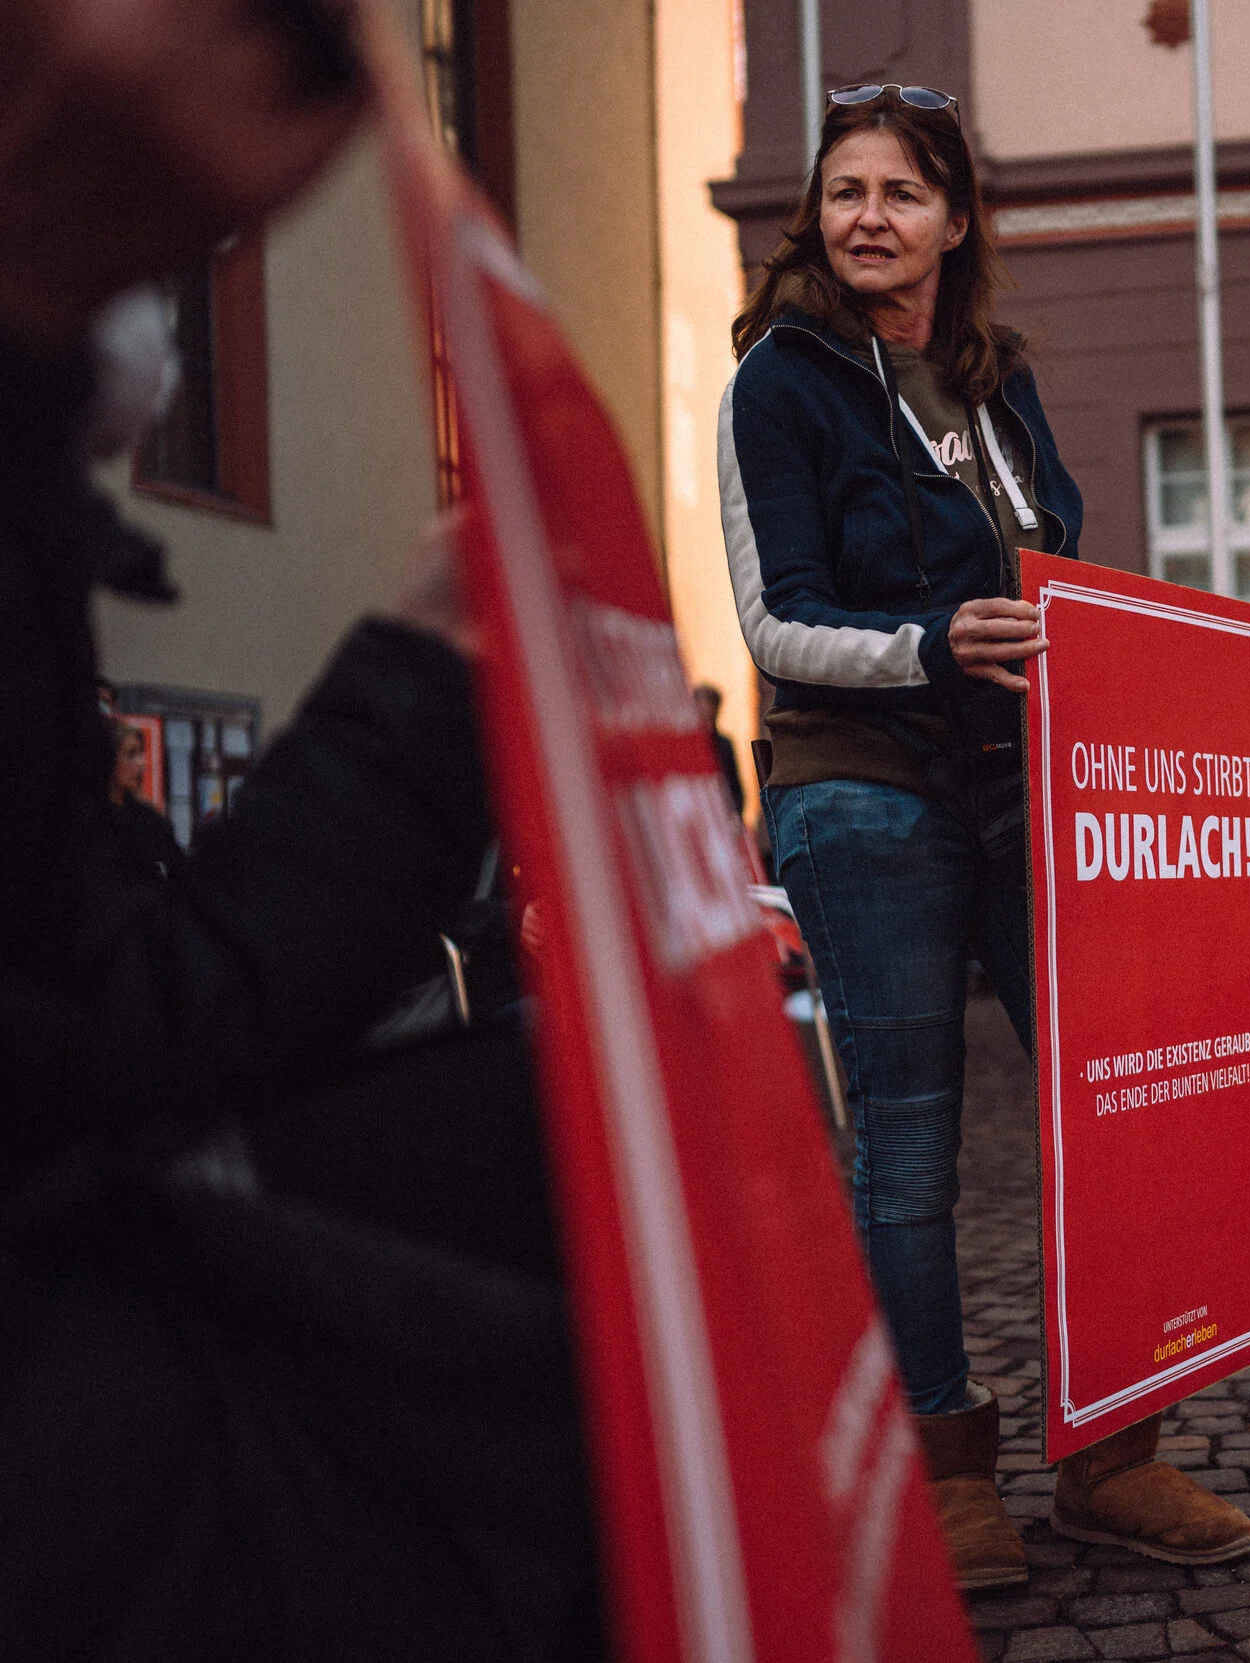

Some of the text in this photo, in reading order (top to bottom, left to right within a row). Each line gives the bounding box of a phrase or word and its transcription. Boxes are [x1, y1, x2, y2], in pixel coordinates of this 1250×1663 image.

[1071, 741, 1138, 792] OHNE
[1144, 747, 1187, 794] UNS
[1086, 1056, 1111, 1083] UNS
[1113, 1051, 1144, 1078] WIRD
[1146, 1047, 1164, 1073] DIE
[1166, 1039, 1212, 1067] EXISTENZ
[1096, 1063, 1250, 1117] DAS ENDE DER BUNTEN VIELFALT!
[1163, 1304, 1208, 1333] UNTERSTÜTZT VON
[1153, 1323, 1218, 1362] durlacherleben
